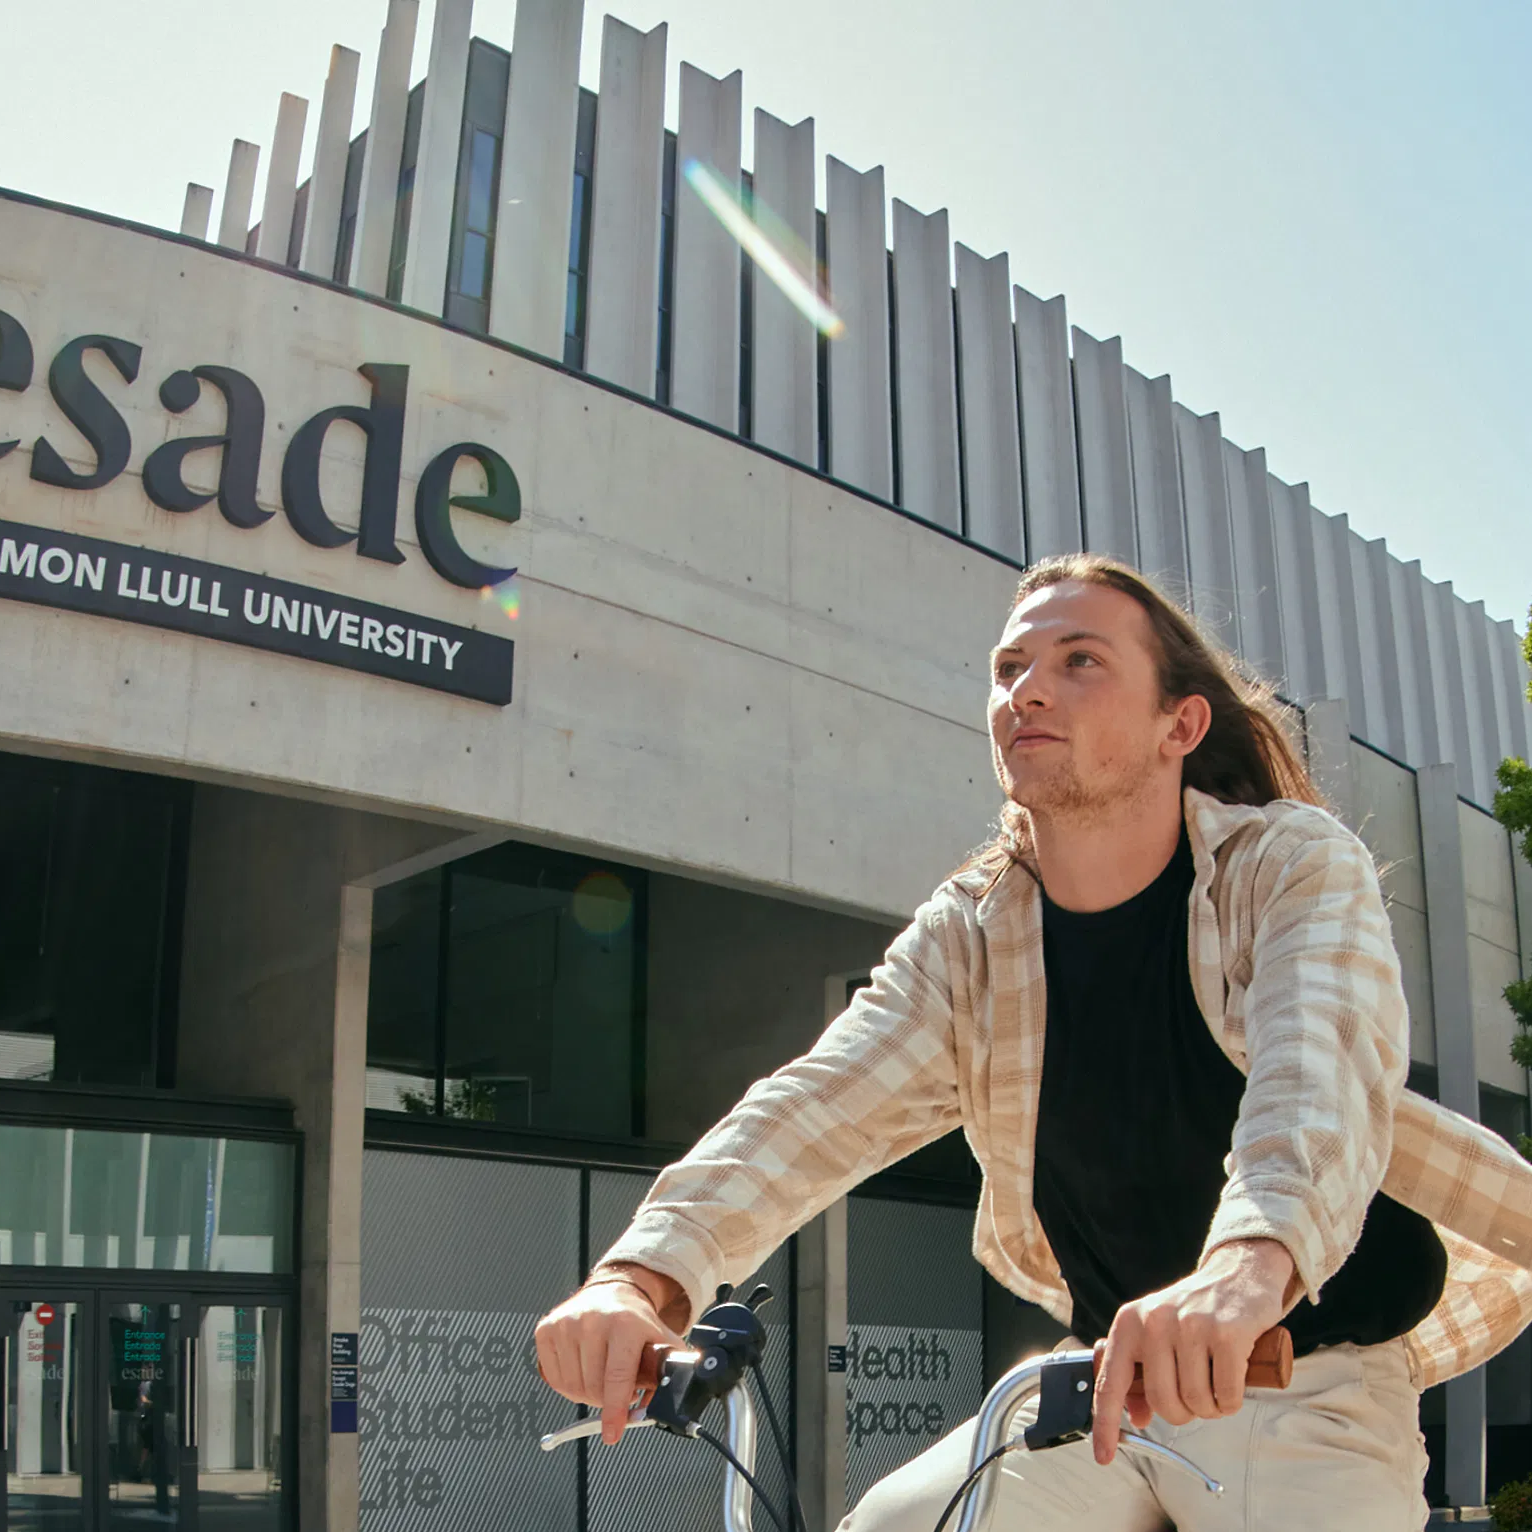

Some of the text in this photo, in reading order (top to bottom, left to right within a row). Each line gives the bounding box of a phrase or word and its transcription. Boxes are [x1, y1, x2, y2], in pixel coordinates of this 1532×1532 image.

[118, 562, 230, 618] LLULL
[244, 590, 464, 671] UNIVERSITY
[124, 1329, 165, 1340] Entrance
[124, 1340, 161, 1350] Entrada
[124, 1351, 161, 1361] Entrada
[121, 1365, 164, 1380] esade
[846, 1389, 944, 1447] pace
